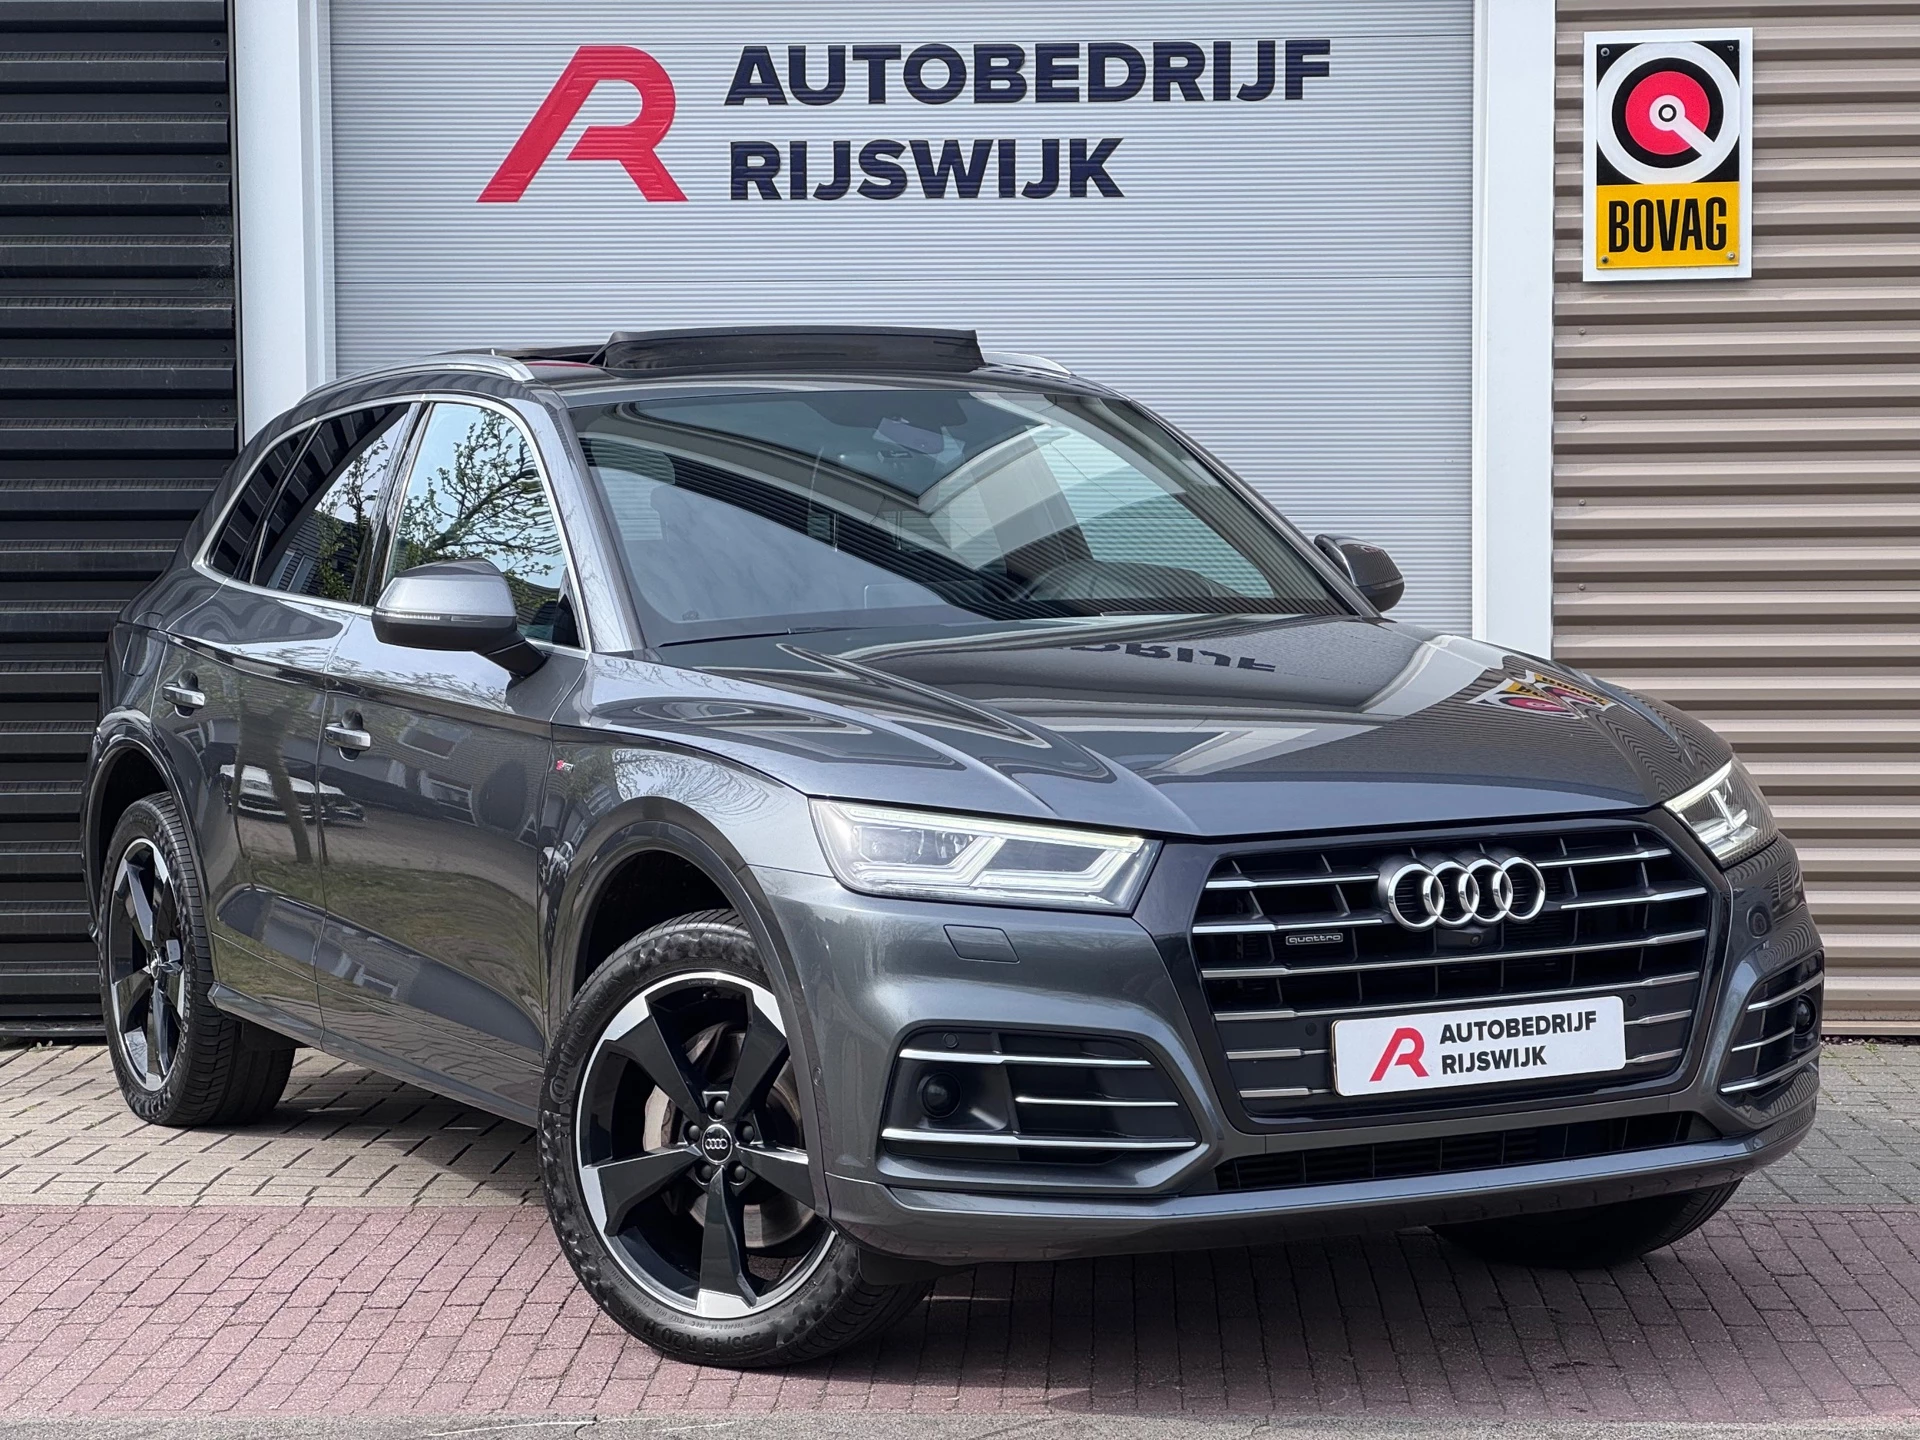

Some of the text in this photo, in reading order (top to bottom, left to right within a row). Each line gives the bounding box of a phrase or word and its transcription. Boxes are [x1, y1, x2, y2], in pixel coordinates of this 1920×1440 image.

[724, 39, 1331, 106] AUTOBEDRIJF
[730, 138, 1125, 201] RIJSWIJK
[1608, 196, 1727, 253] BOVAG
[1288, 933, 1341, 945] quattro
[1439, 1010, 1597, 1045] AUTOBEDRIJF
[1441, 1045, 1547, 1075] RIJSWIJK
